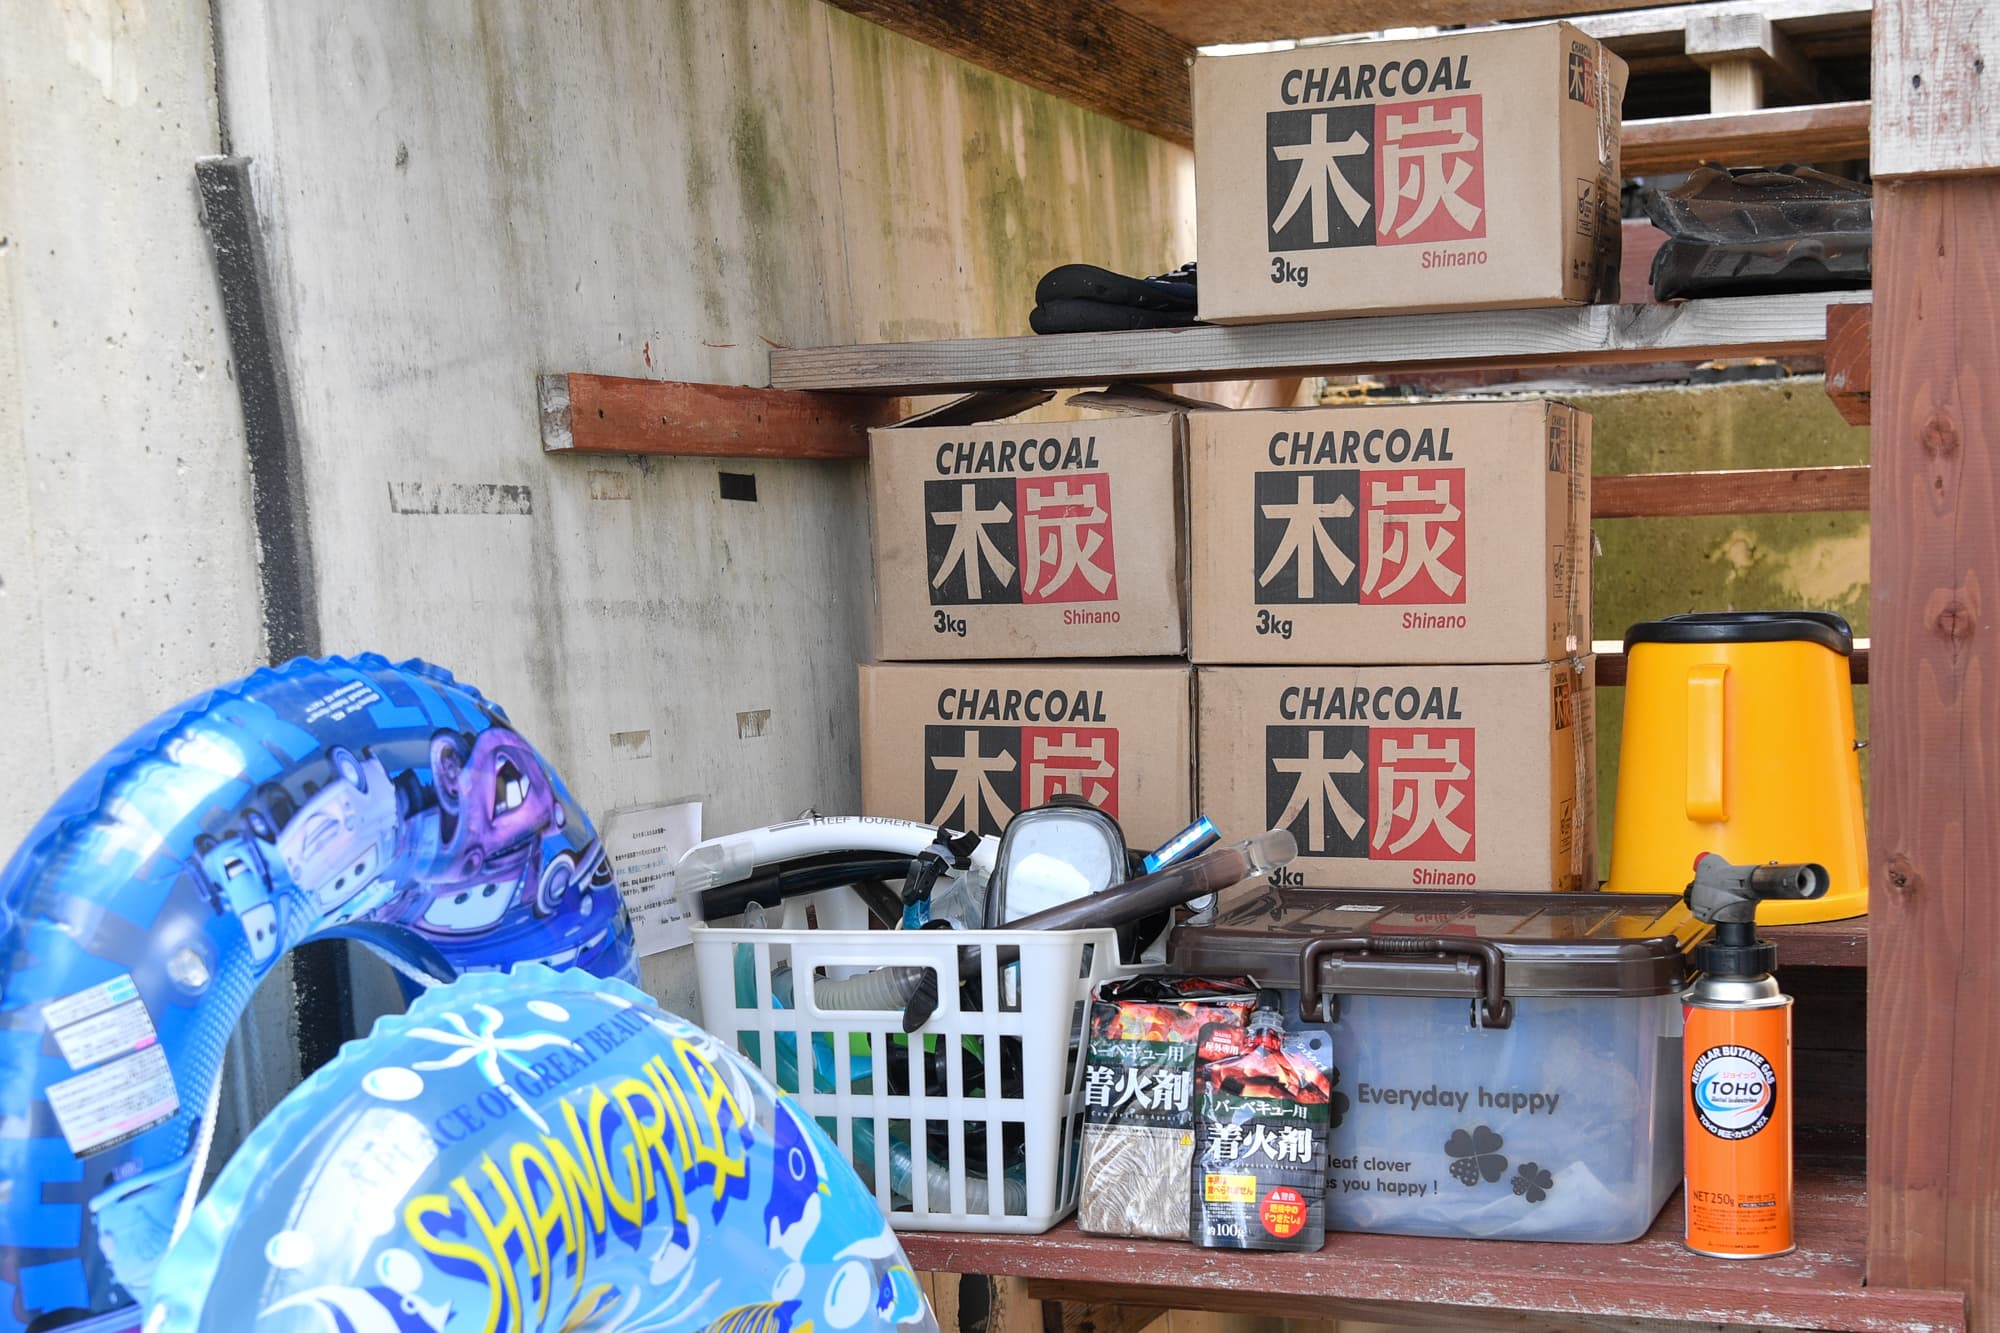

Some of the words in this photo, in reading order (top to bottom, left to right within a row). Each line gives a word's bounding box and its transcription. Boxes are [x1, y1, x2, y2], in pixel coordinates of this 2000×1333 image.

[1281, 55, 1472, 105] CHARCOAL
[1272, 105, 1482, 243] 木炭
[1270, 256, 1308, 287] 3kg
[1421, 249, 1488, 269] Shinano
[935, 436, 1099, 475] CHARCOAL
[1268, 427, 1454, 466] CHARCOAL
[929, 481, 1113, 600] 木炭
[1258, 475, 1463, 600] 木炭
[933, 610, 967, 637] 3kg
[1063, 610, 1120, 625] Shinano
[1255, 609, 1293, 640] 3kg
[1401, 612, 1466, 630] Shinano
[937, 687, 1107, 722] CHARCOAL
[1279, 686, 1463, 721] CHARCOAL
[1271, 730, 1472, 855] 木炭
[812, 816, 852, 827] REEF
[1412, 867, 1477, 887] Shinano
[512, 1040, 595, 1099] GREAT
[1692, 1048, 1722, 1084] REGULAR
[1722, 1046, 1765, 1066] BUTANE
[1760, 1063, 1776, 1085] GAS
[1085, 1065, 1191, 1112] 着火剤
[1358, 1083, 1469, 1113] Everyday
[1479, 1086, 1560, 1114] happy
[1711, 1081, 1762, 1095] TOHO
[1214, 1099, 1308, 1120] バーベキュー用
[1207, 1122, 1313, 1163] 着火剤
[1327, 1154, 1358, 1170] leaf
[1363, 1157, 1411, 1172] clover
[404, 1037, 747, 1333] SHANGRILA
[1342, 1179, 1370, 1193] you
[1376, 1178, 1427, 1196] happy
[1693, 1191, 1710, 1202] NET
